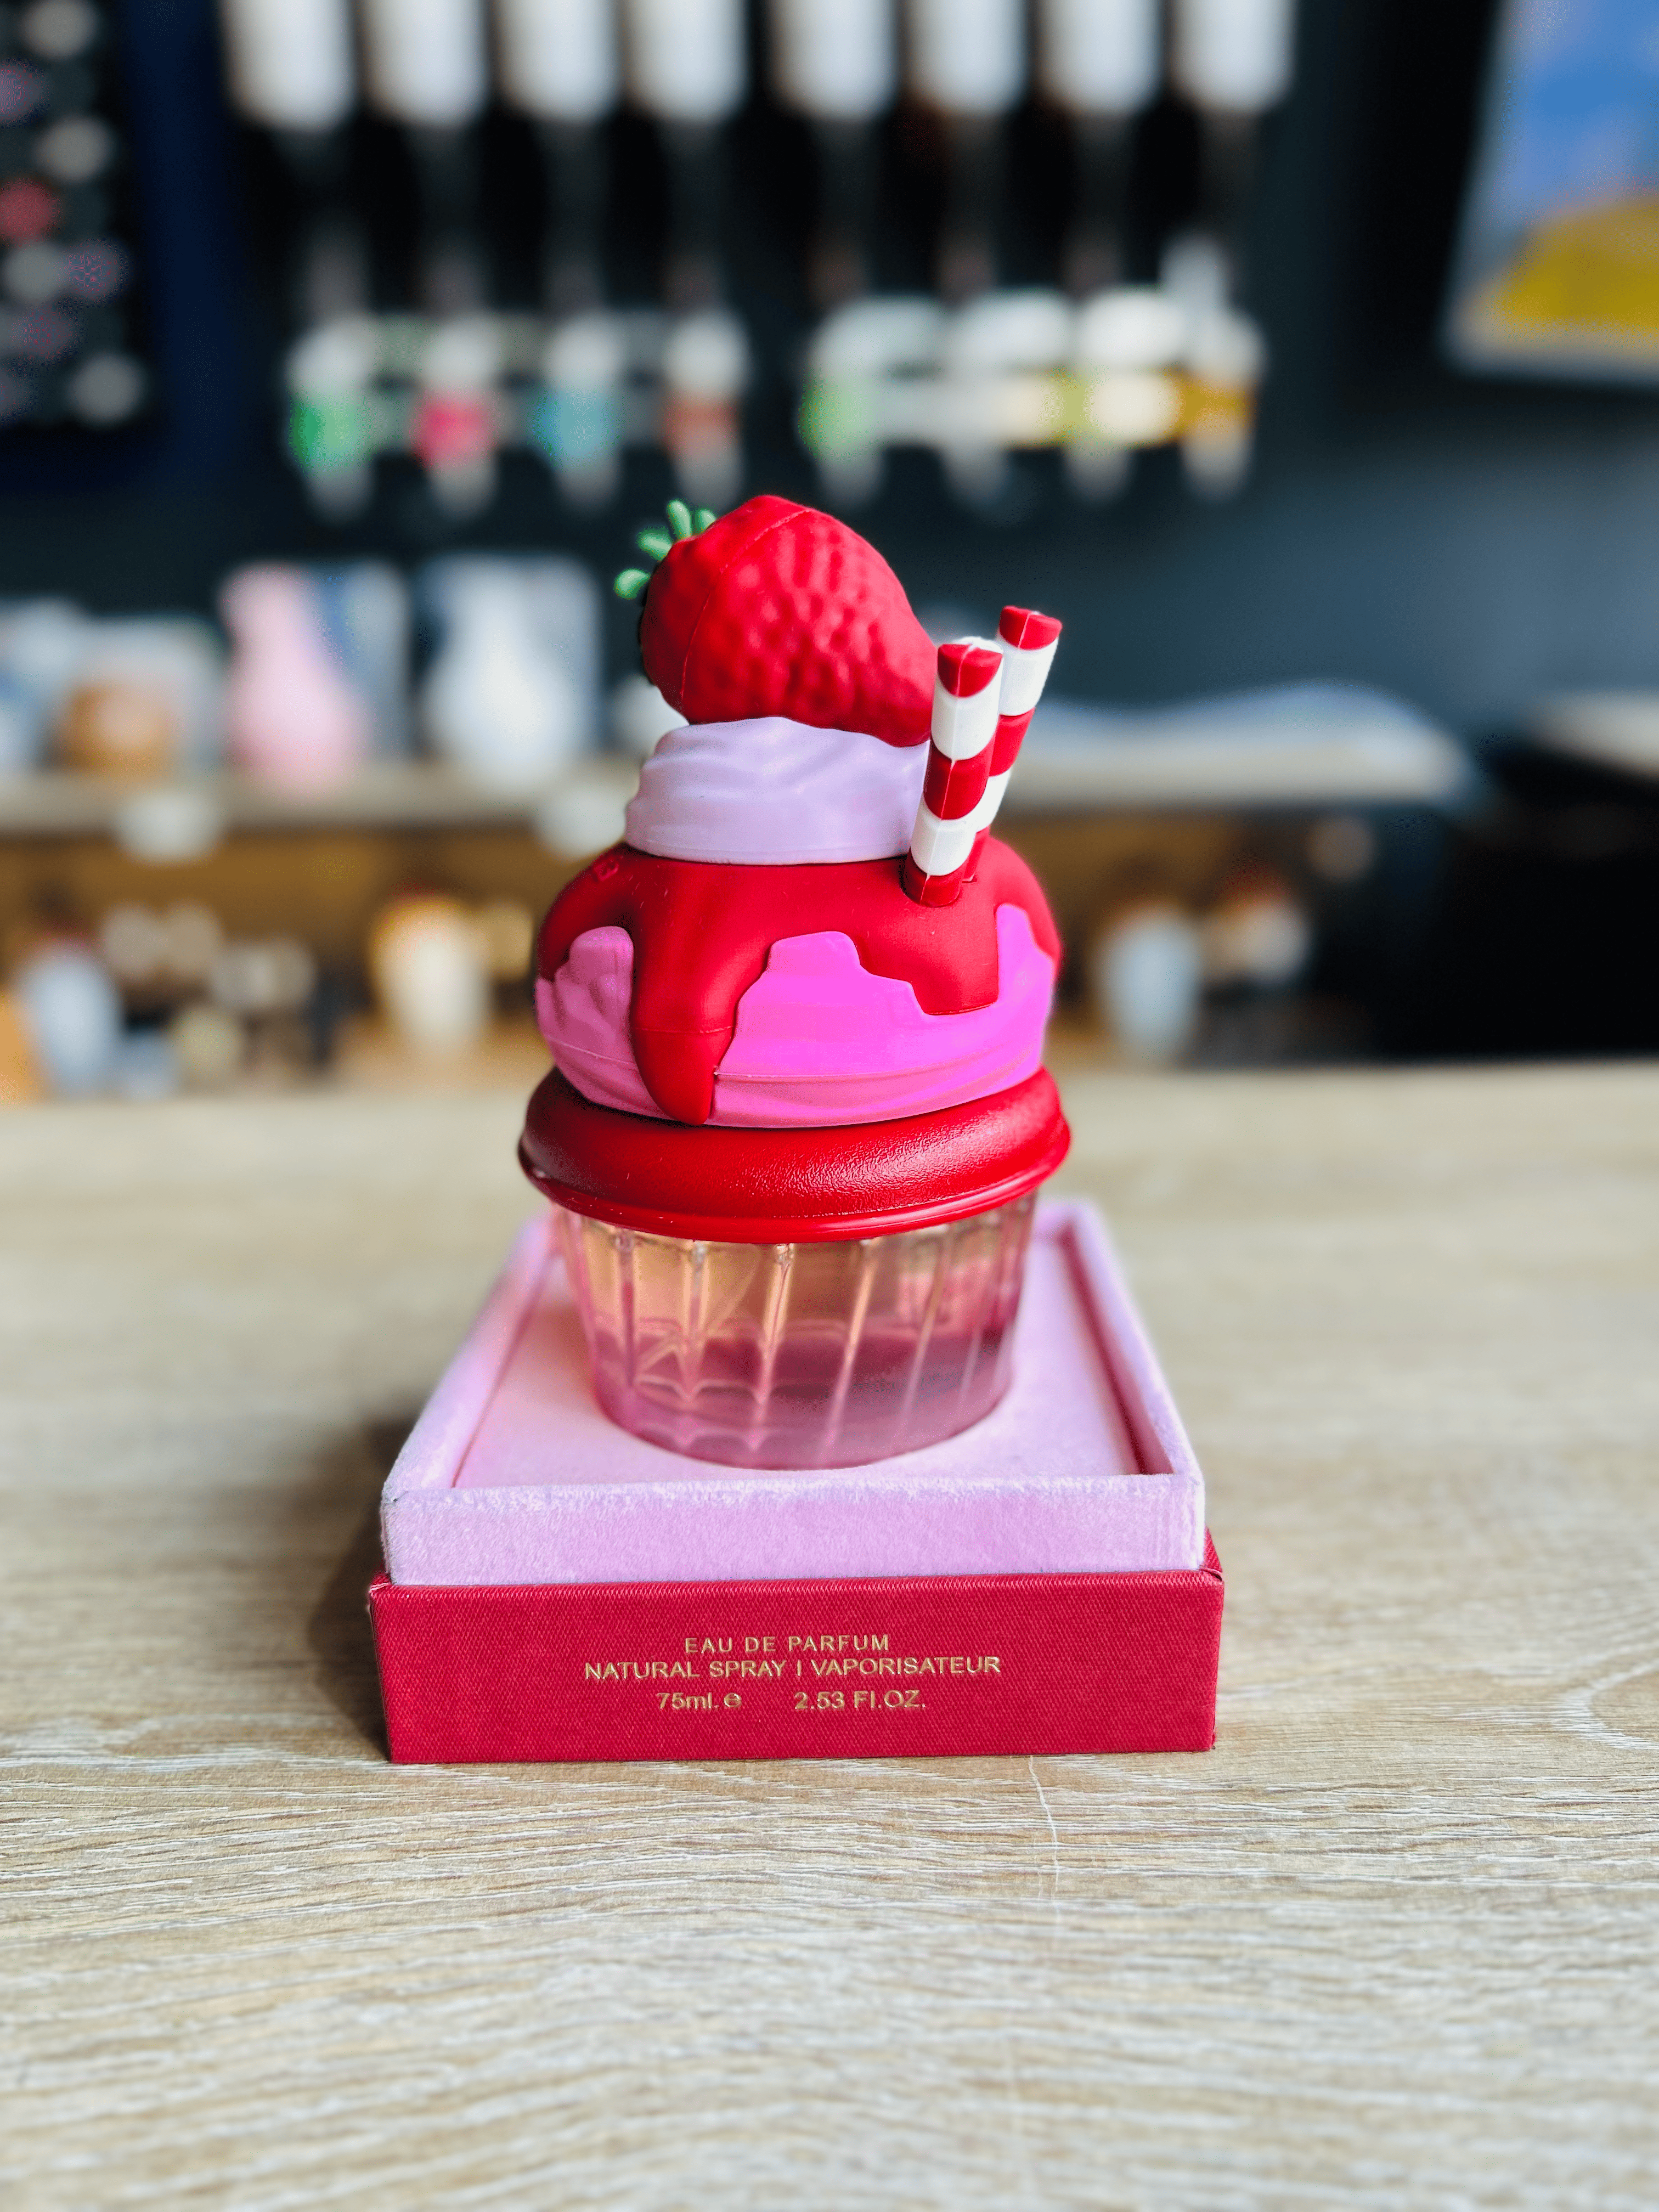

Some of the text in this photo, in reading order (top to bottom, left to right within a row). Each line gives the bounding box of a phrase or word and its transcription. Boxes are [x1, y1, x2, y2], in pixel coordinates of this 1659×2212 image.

[685, 1634, 889, 1654] EAU DE PARFUM
[585, 1661, 700, 1679] NATURAL
[709, 1660, 787, 1678] SPRAY
[811, 1656, 1001, 1676] VAPORISATEUR
[794, 1690, 845, 1709] 2.53
